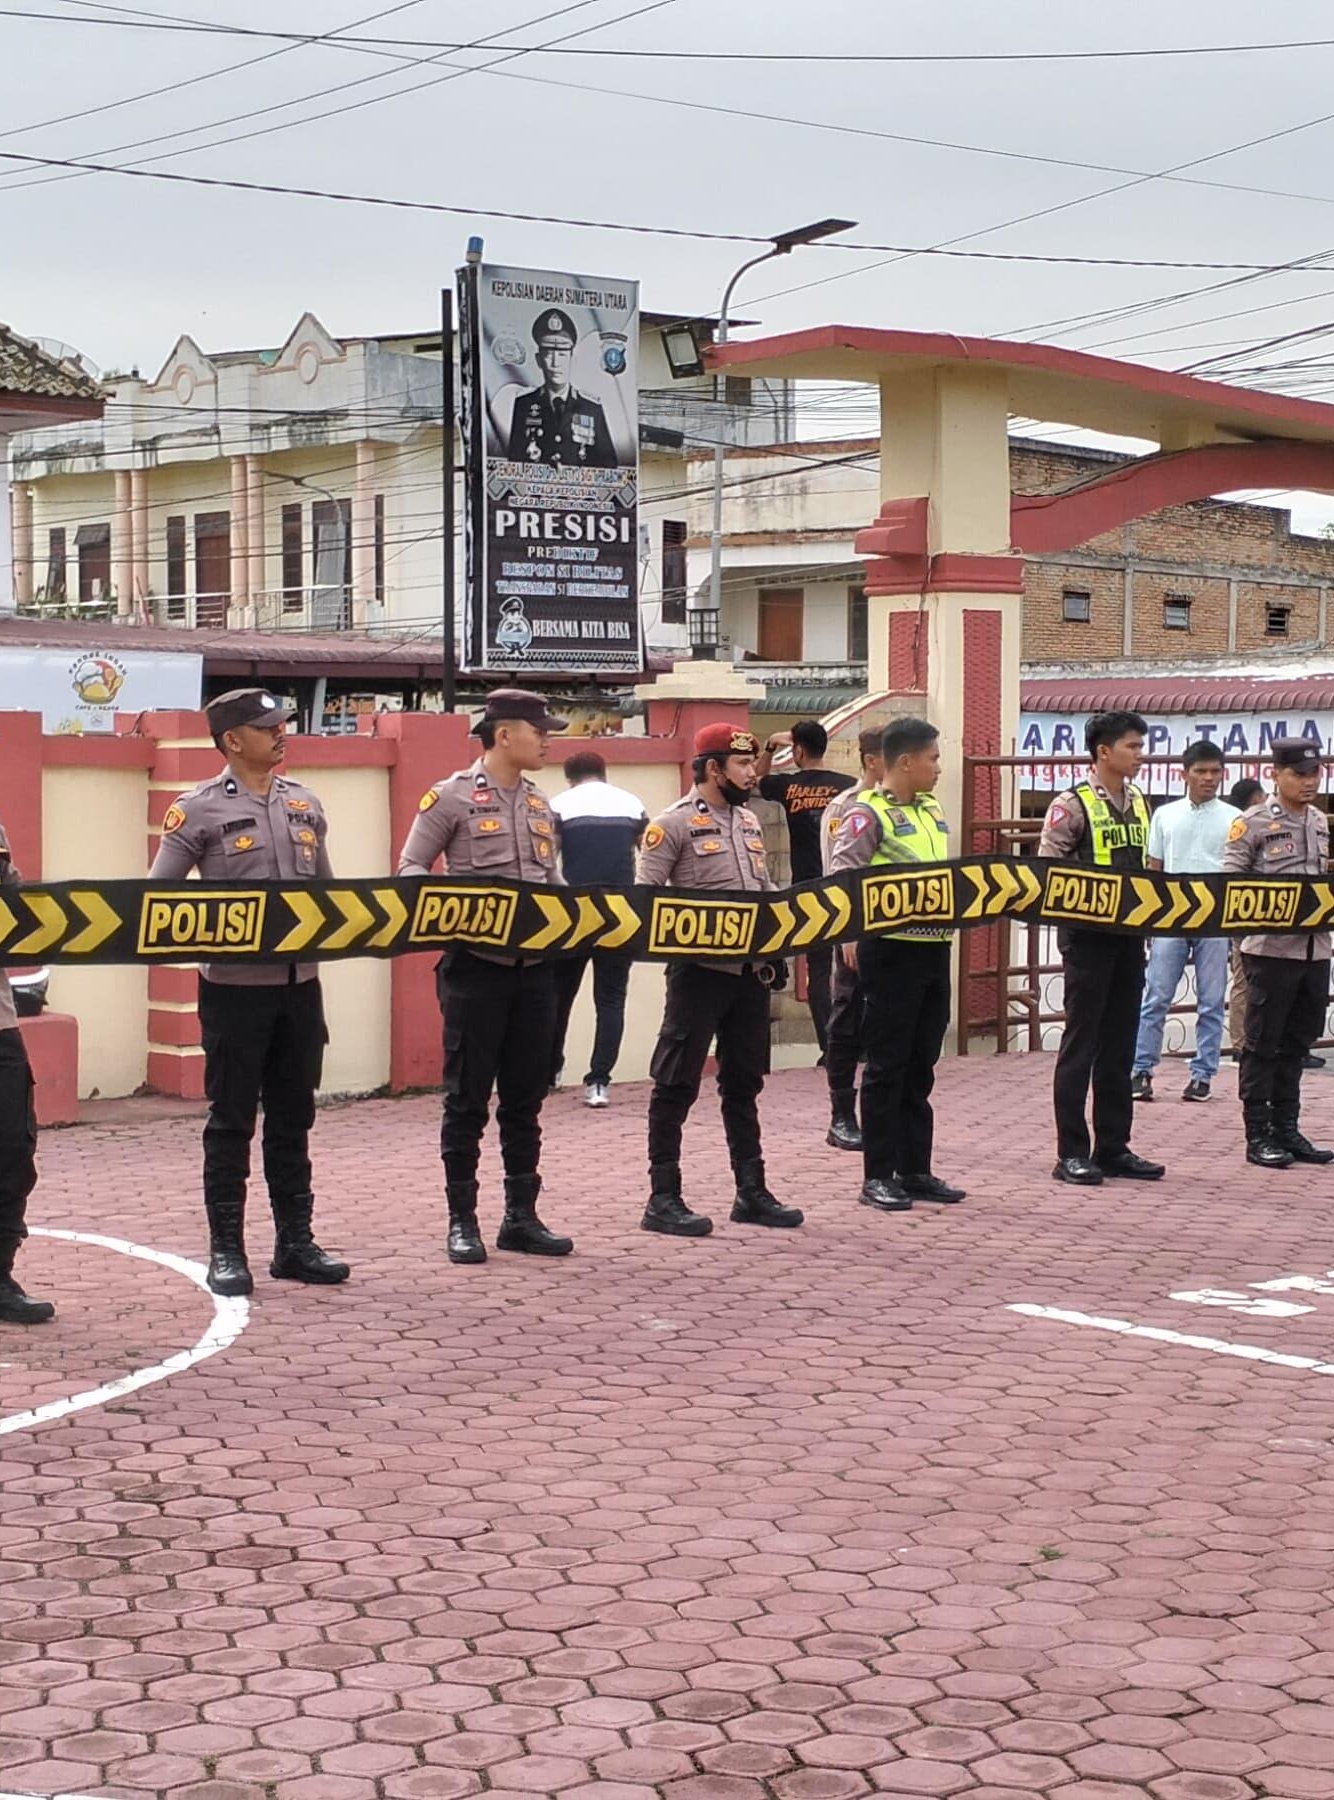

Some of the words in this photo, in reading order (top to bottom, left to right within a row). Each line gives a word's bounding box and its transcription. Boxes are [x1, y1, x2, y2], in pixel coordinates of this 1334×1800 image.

[492, 281, 534, 300] KEPOLISIAN
[536, 285, 564, 304] DAERAH
[565, 288, 603, 308] SUMATERA
[604, 292, 628, 310] UTARA
[495, 510, 630, 543] PRESISI
[532, 619, 579, 638] BERSAMA
[581, 620, 606, 639] KITA
[607, 621, 631, 640] BISA
[786, 783, 839, 801] HARLEY-
[1102, 823, 1147, 849] POLISI
[867, 875, 951, 919] POLISI
[1047, 873, 1118, 916] POLISI
[1228, 885, 1298, 922] POLISI
[147, 899, 257, 945] POLISI
[418, 895, 509, 935] POLISI
[656, 906, 750, 948] POLISI
